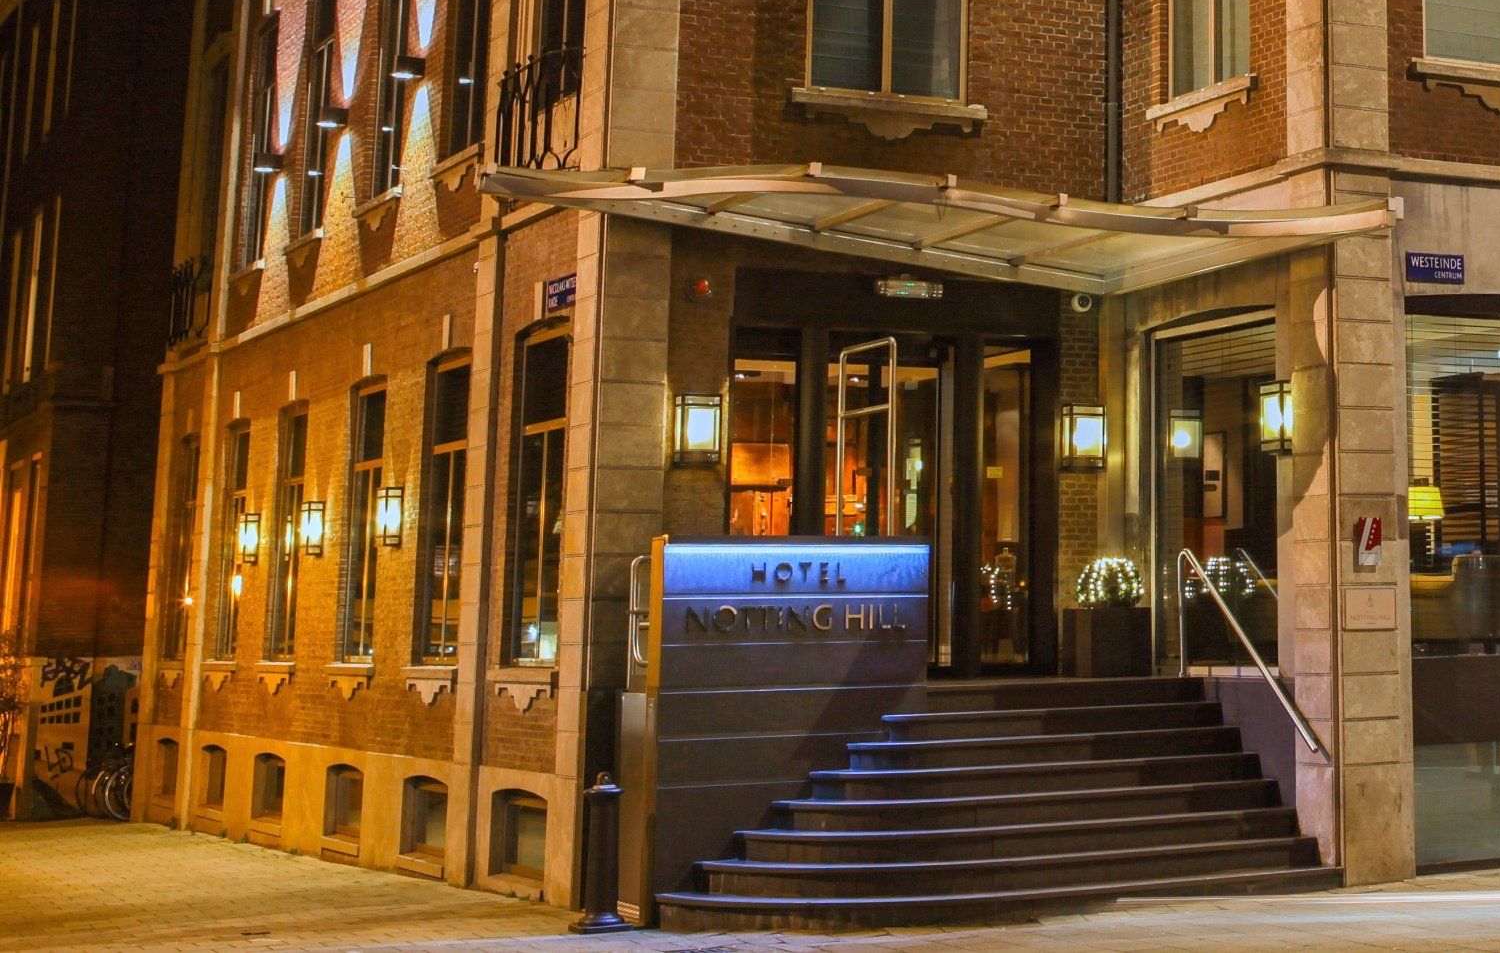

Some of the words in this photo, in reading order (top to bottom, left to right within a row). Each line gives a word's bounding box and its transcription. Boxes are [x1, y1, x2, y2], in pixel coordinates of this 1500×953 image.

[1410, 256, 1462, 270] WESTEINDE
[1434, 270, 1462, 280] CENTRUM
[751, 561, 847, 583] HOTEL
[685, 604, 834, 632] NOTTING
[845, 603, 906, 631] HILL
